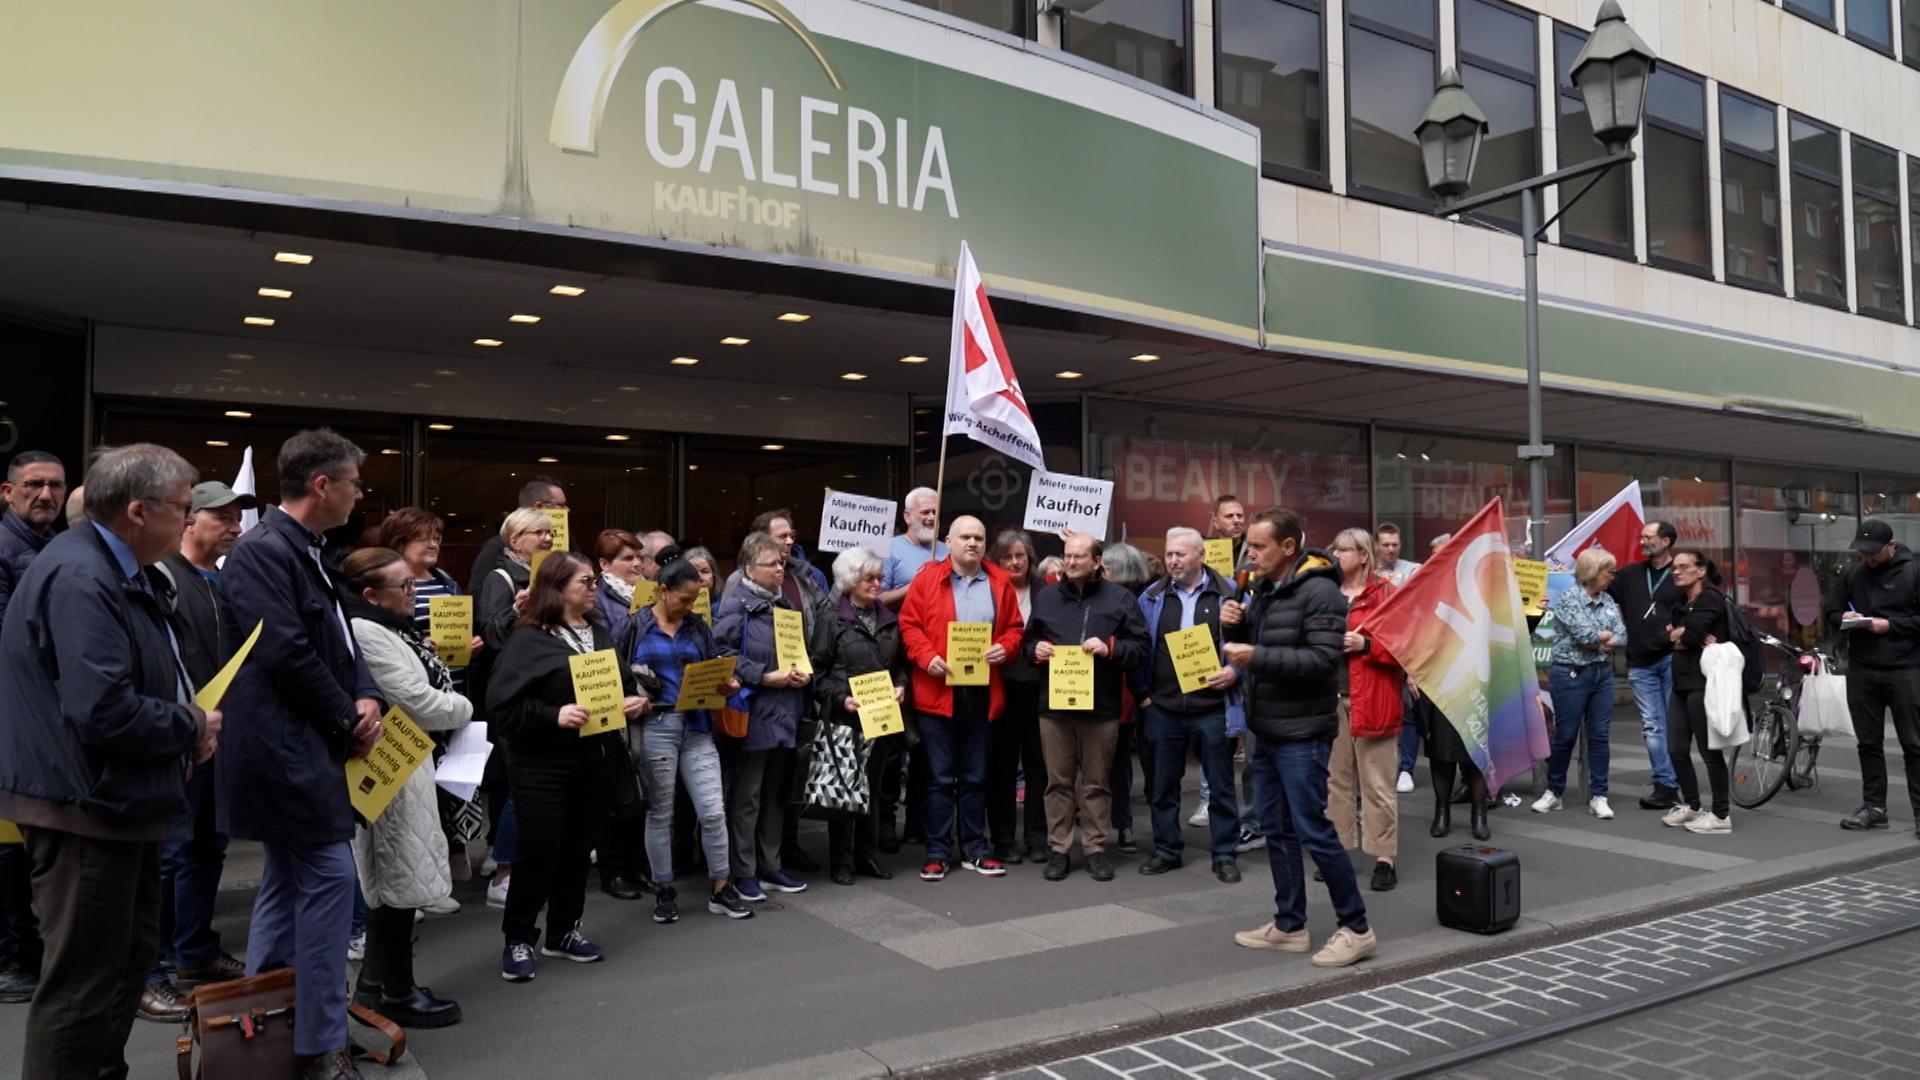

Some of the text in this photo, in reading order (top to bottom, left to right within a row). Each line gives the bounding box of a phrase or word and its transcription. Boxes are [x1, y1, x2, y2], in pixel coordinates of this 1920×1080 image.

[645, 66, 959, 219] GALERIA
[1039, 478, 1103, 495] Miete runter!
[1126, 454, 1291, 506] BEAUTY
[831, 498, 889, 515] Miete runter!
[1036, 495, 1102, 517] Kaufhof
[829, 515, 887, 536] Kaufhof
[1032, 519, 1068, 529] retten!
[826, 539, 860, 548] retten!
[389, 714, 430, 752] KAUFHOF
